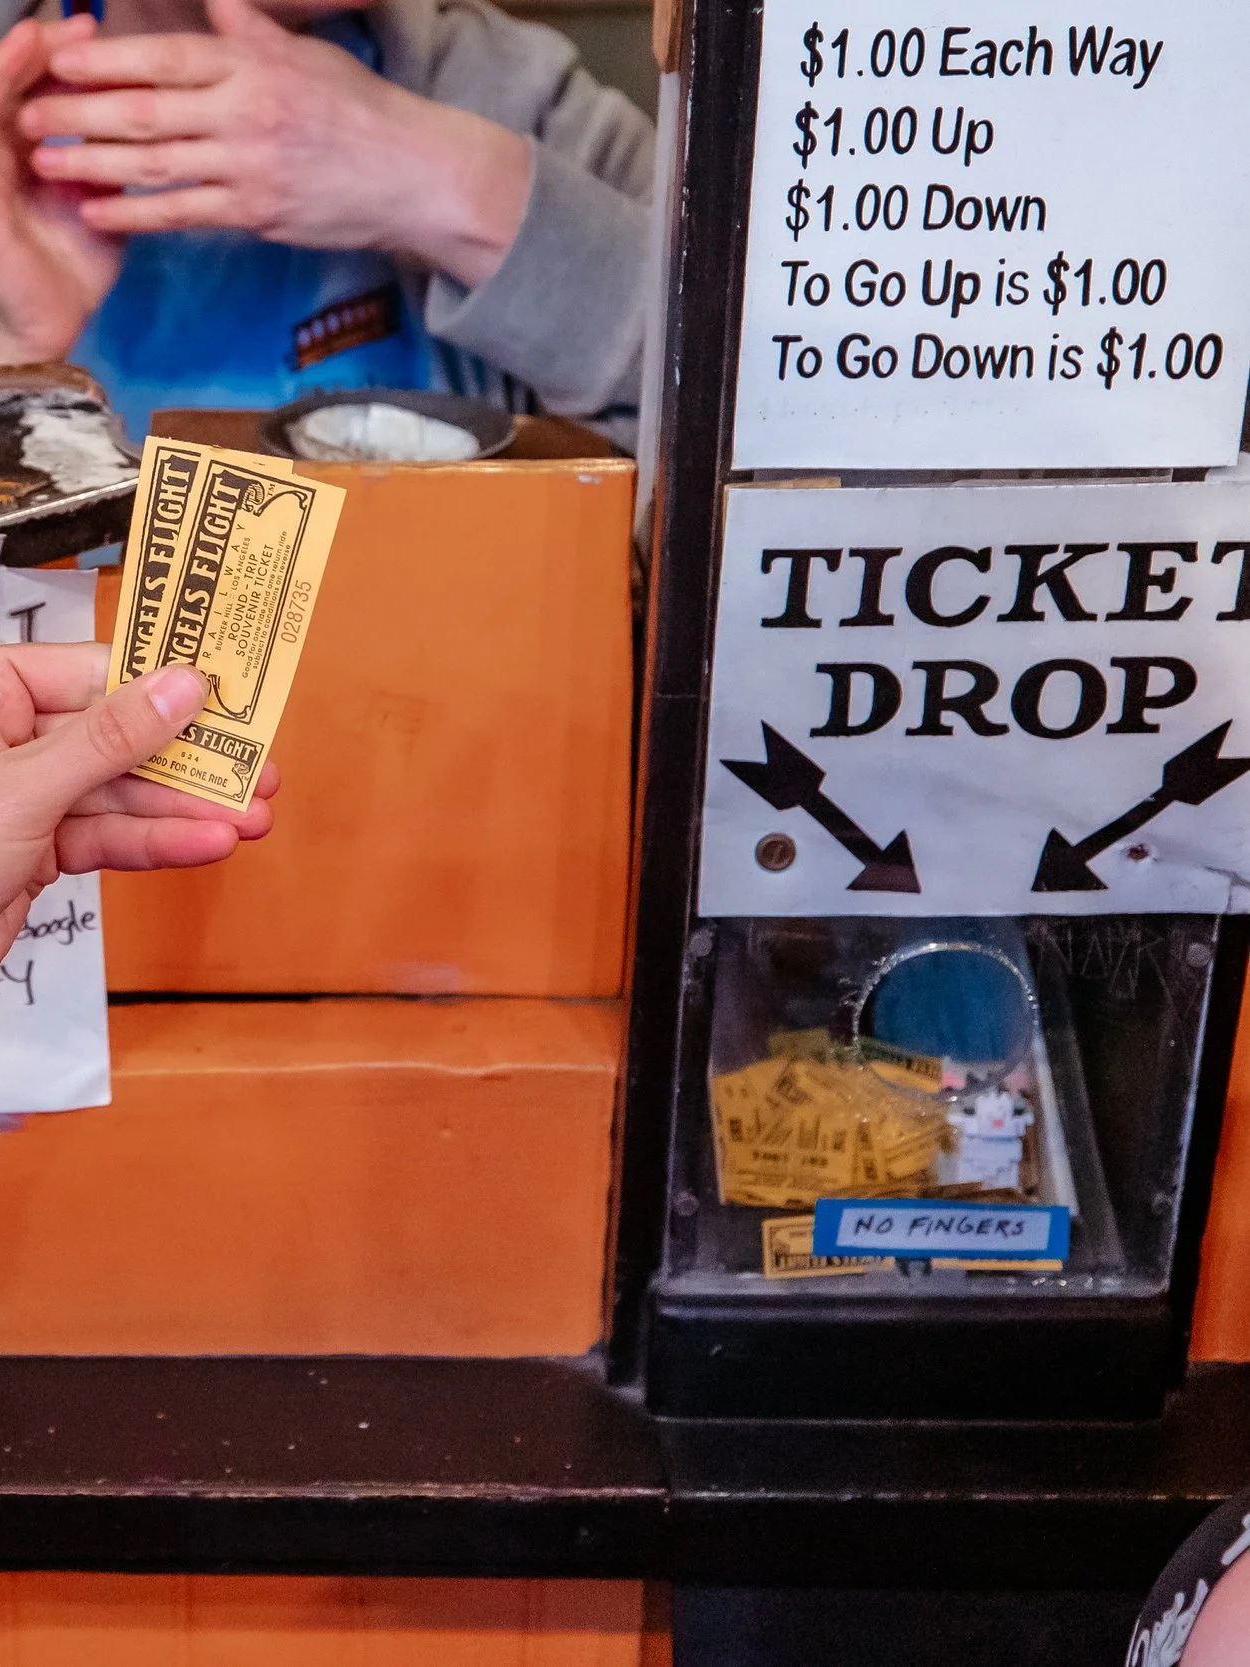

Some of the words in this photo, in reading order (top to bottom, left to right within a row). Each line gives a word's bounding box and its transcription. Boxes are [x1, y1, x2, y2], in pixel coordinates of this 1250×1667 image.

[800, 21, 926, 87] $1.00
[939, 25, 1052, 79] Each
[1068, 25, 1164, 90] Way
[793, 101, 918, 170] $1.00
[932, 106, 995, 167] Up
[786, 179, 909, 242] $1.00
[922, 183, 1047, 232] Down
[780, 260, 830, 307] To
[844, 258, 906, 307] Go
[921, 258, 982, 319] Up
[995, 258, 1030, 307] is
[1043, 251, 1167, 316] $1.00
[771, 334, 823, 382] To
[836, 332, 899, 380] Go
[911, 332, 1034, 380] Down
[1048, 333, 1083, 381] is
[1096, 326, 1224, 390] $1.00
[149, 462, 190, 562] FLIGHT
[279, 531, 287, 547] ride
[235, 537, 251, 574] ANGELES
[272, 548, 282, 572] return
[279, 544, 291, 574] reverse
[166, 588, 210, 666] NGELS
[190, 477, 241, 581] FLIGHT
[231, 575, 241, 591] LOS
[267, 574, 275, 589] one
[276, 575, 283, 586] on
[760, 541, 1250, 628] TICKET
[224, 603, 233, 619] HILL
[227, 593, 248, 641] ROUND
[244, 553, 258, 580] TRIP
[235, 591, 261, 657] SOUVENIR
[254, 544, 274, 587] TICKET
[262, 590, 271, 607] and
[264, 587, 279, 629] conditions
[280, 579, 312, 644] 028735
[257, 609, 266, 626] ride
[215, 620, 229, 651] BUNKER
[249, 643, 257, 655] for
[253, 627, 262, 641] one
[261, 630, 268, 639] to
[242, 655, 254, 679] Good
[253, 640, 265, 669] subject
[809, 656, 1198, 739] DROP
[200, 730, 255, 761] FLIGHT
[170, 760, 188, 774] FOR
[190, 767, 207, 780] ONE
[208, 773, 228, 788] RIDE
[854, 1214, 894, 1235] NO
[907, 1216, 1026, 1239] FINGERS
